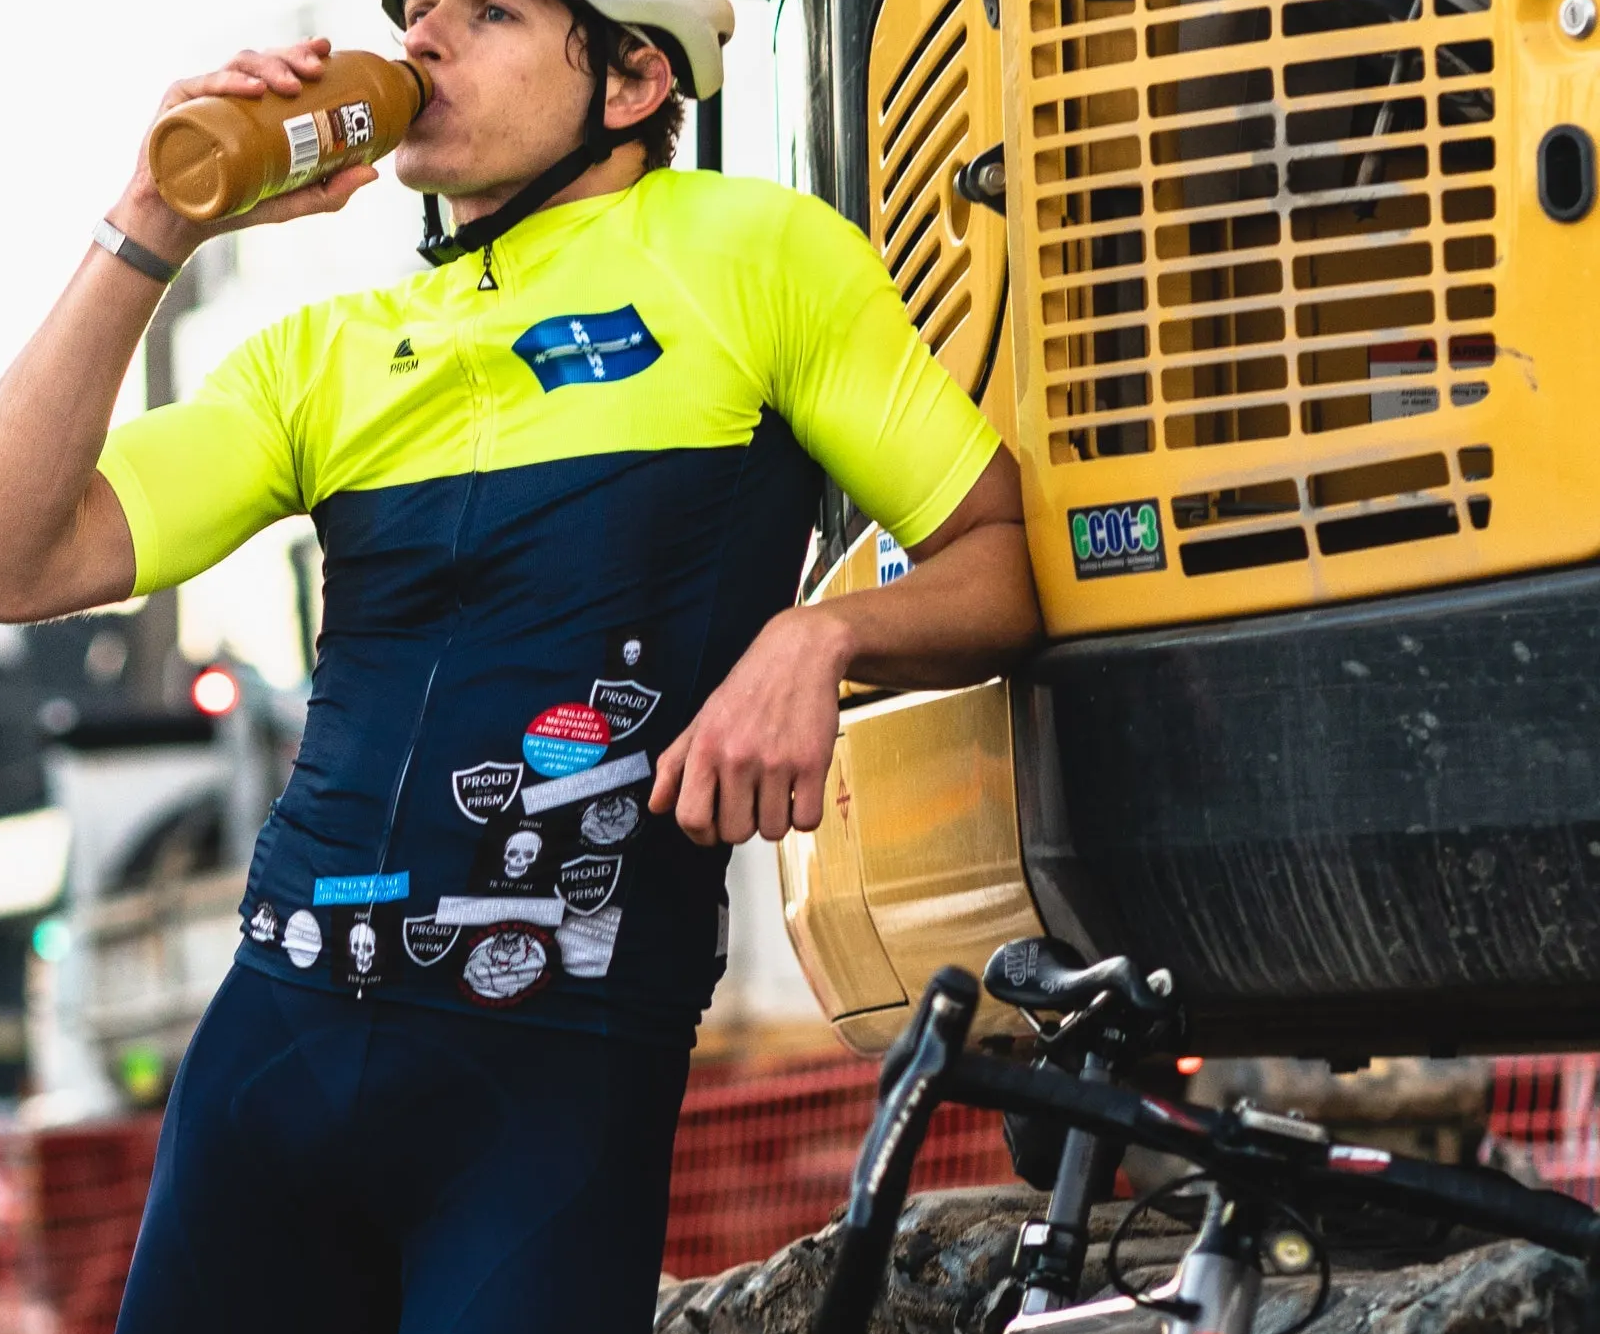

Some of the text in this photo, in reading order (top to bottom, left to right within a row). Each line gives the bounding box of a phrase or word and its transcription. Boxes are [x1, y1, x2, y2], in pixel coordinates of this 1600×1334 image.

[348, 101, 370, 146] ICE
[389, 360, 419, 375] PRISM
[600, 688, 648, 710] PROUD
[557, 708, 595, 721] SKILLED
[545, 716, 600, 732] MECHANICS
[462, 772, 512, 790] PROUD
[467, 793, 504, 809] PRISM
[561, 864, 611, 882] PROUD
[568, 886, 604, 902] PRISM
[411, 924, 452, 936] PROUD
[412, 942, 443, 953] PRISM
